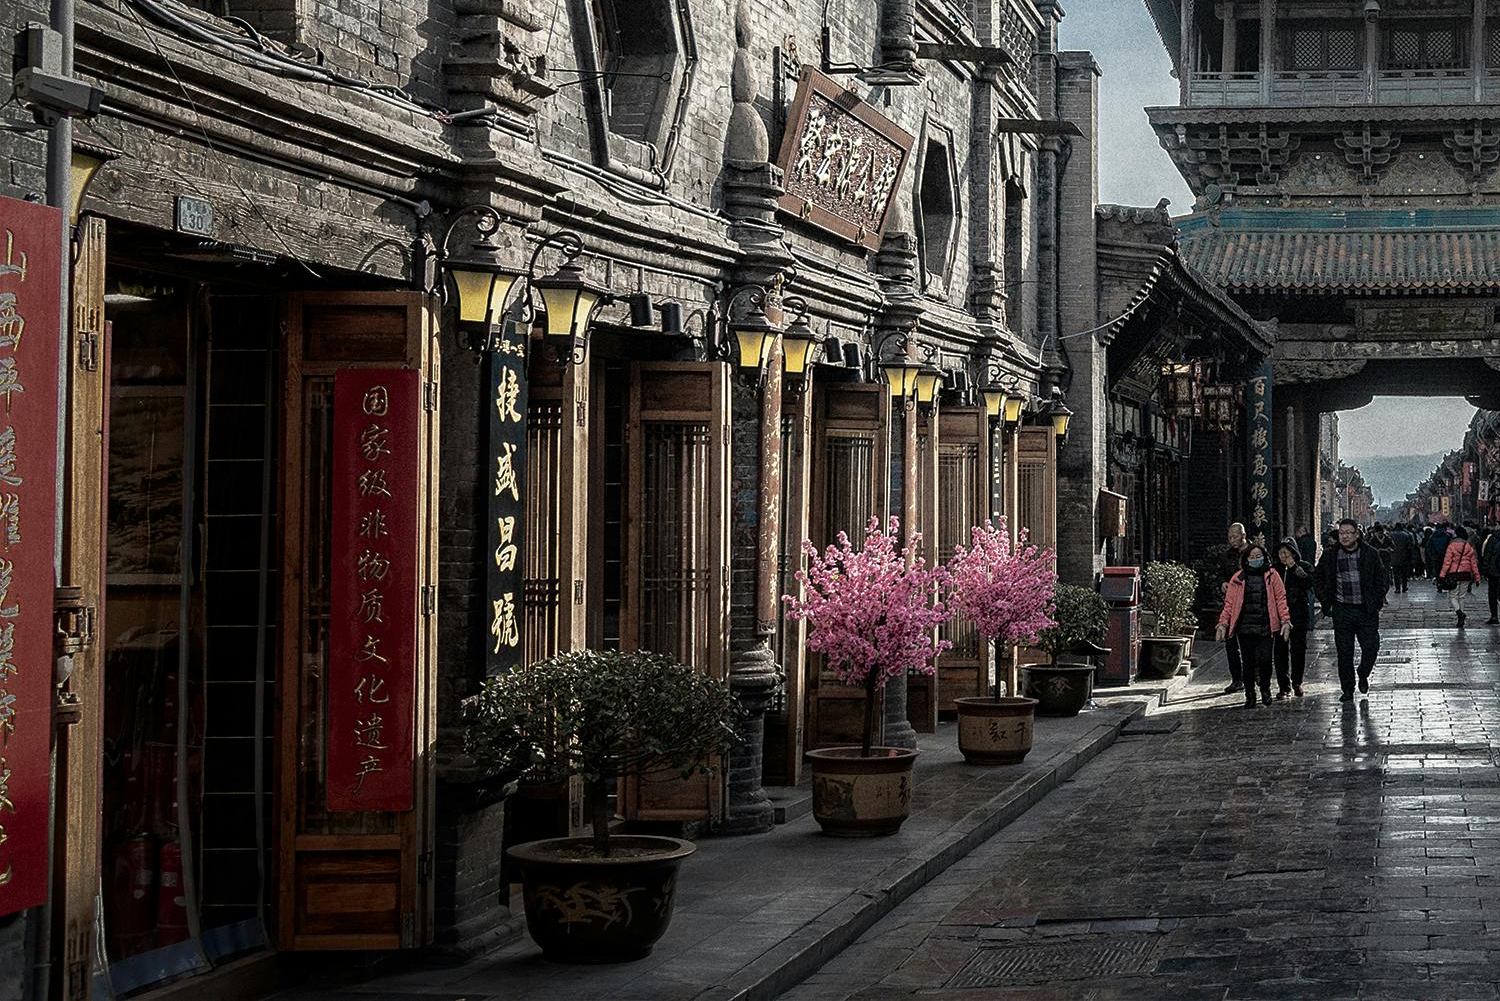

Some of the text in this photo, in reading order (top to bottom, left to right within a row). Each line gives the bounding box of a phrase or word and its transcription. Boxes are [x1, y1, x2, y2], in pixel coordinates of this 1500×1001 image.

[188, 213, 204, 230] 30
[352, 385, 393, 797] 国家级非物质文化遗产
